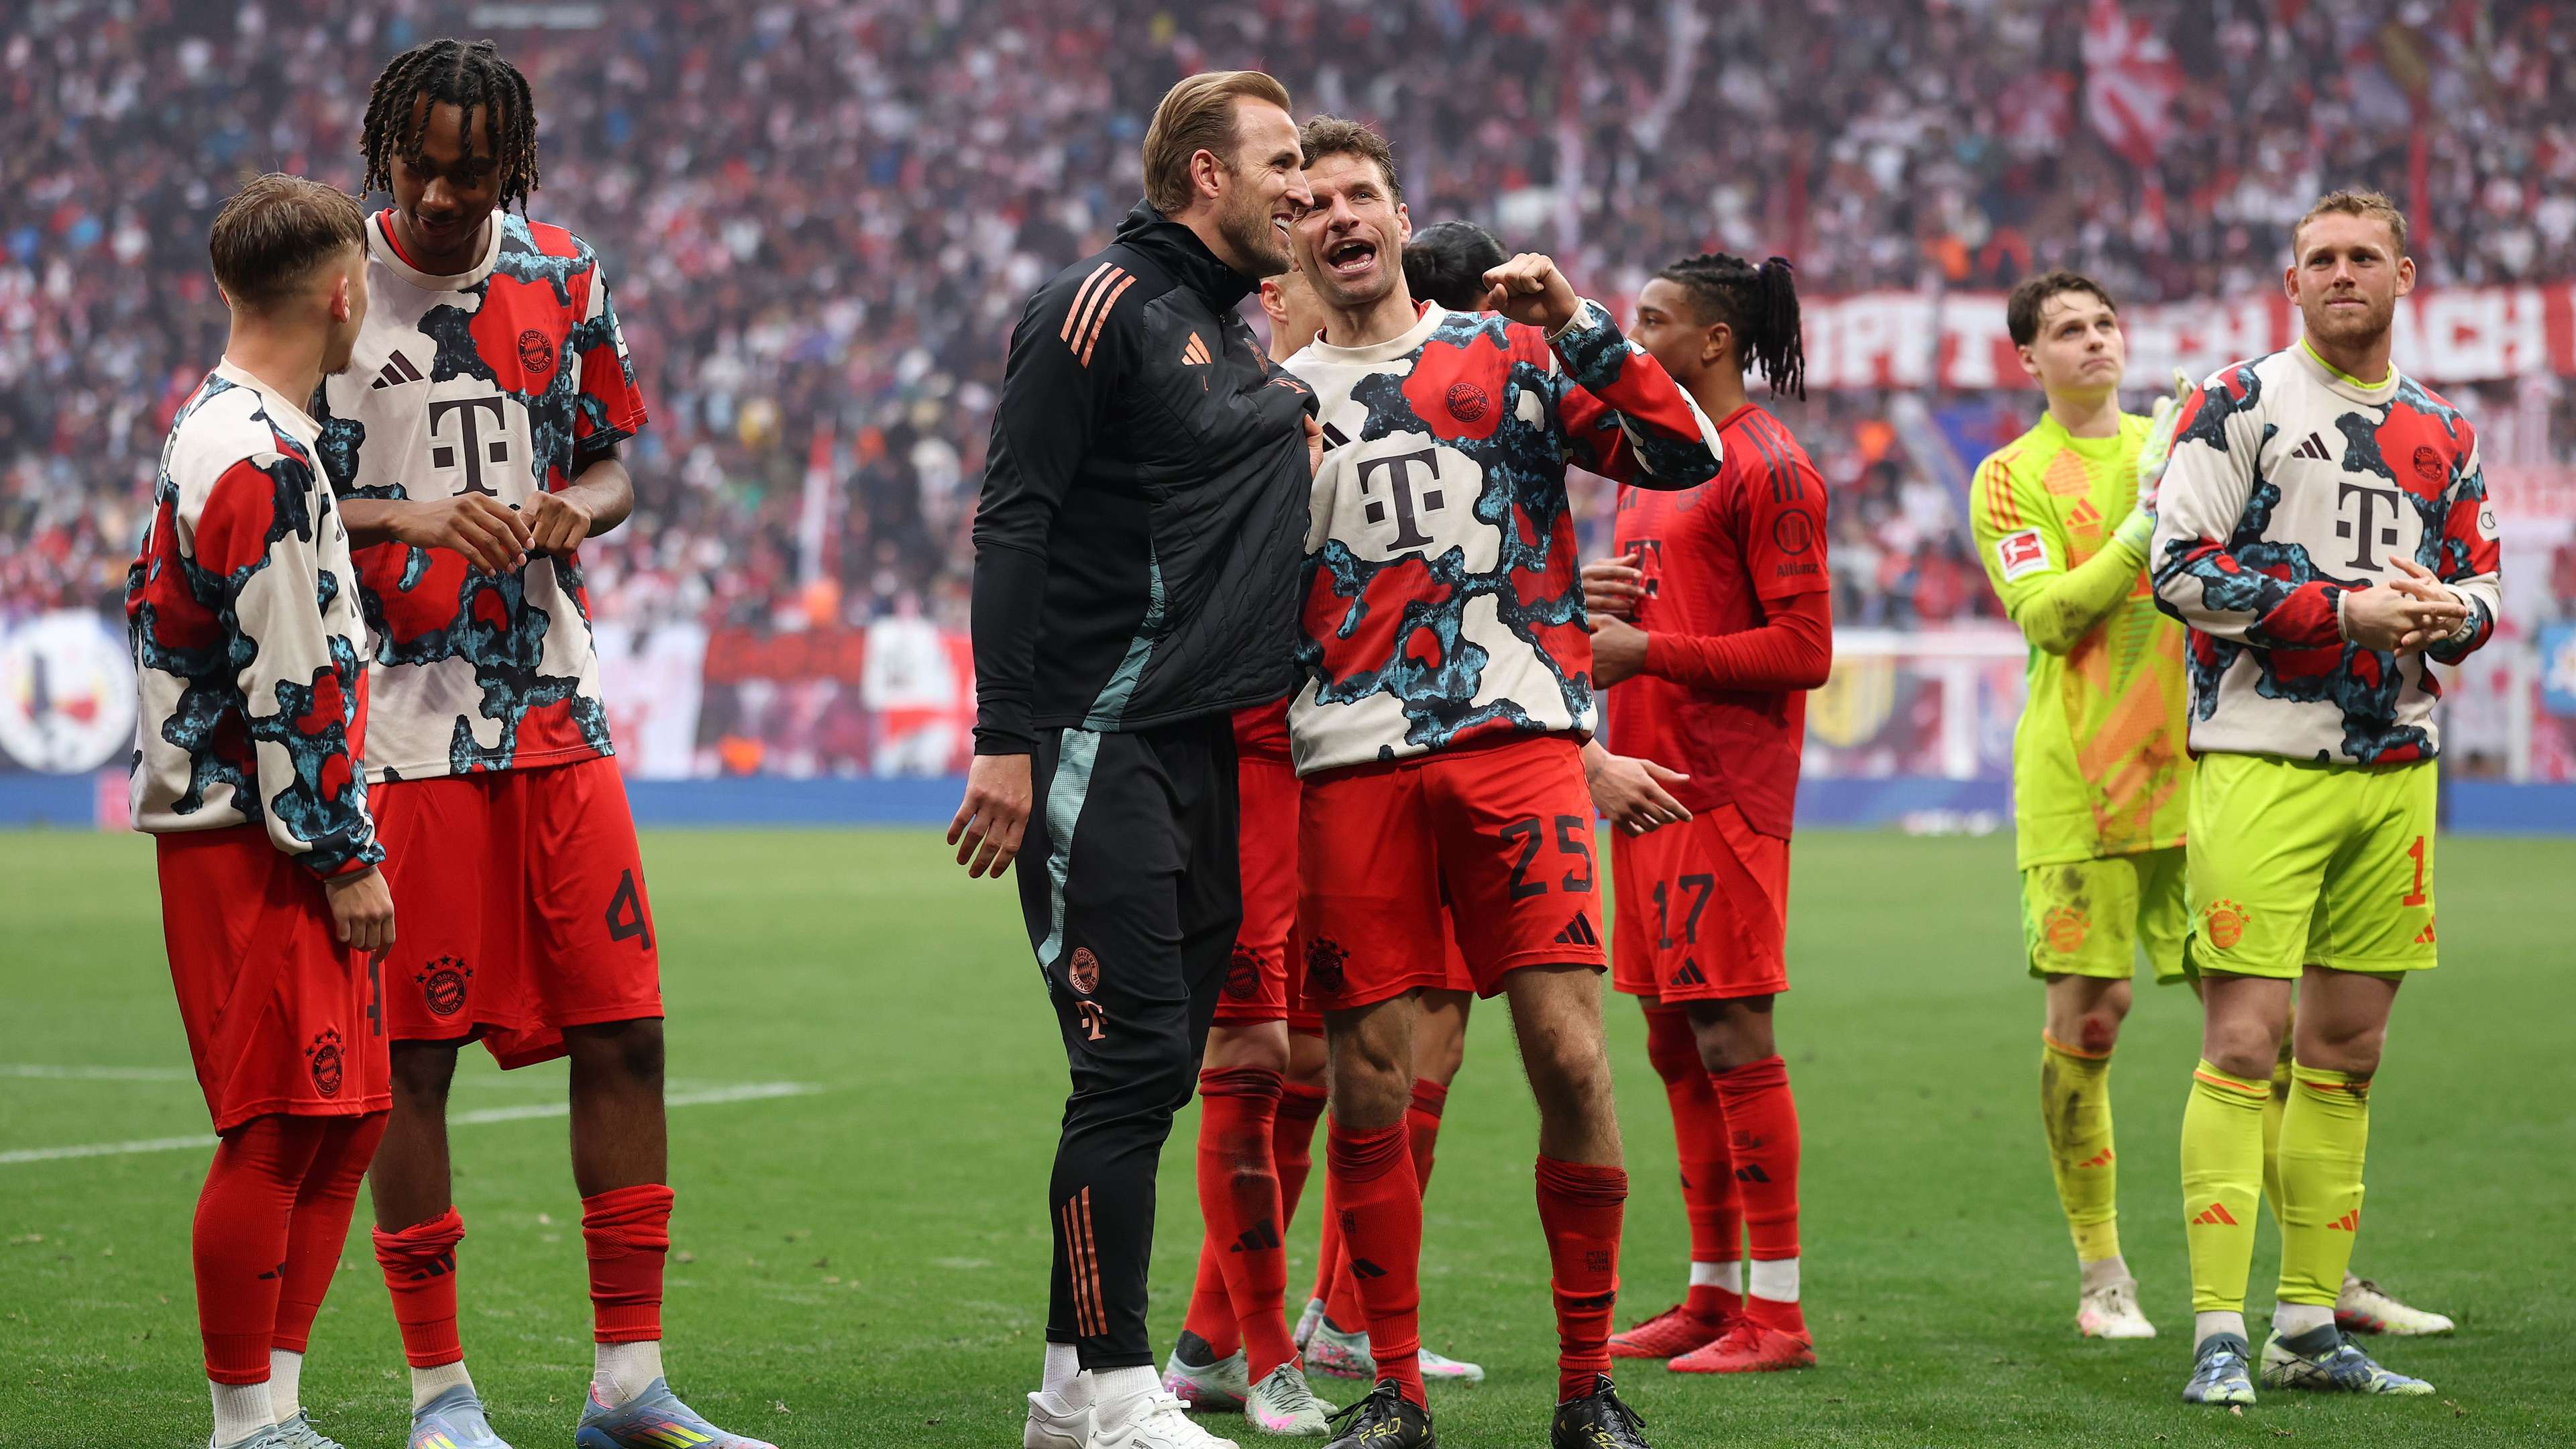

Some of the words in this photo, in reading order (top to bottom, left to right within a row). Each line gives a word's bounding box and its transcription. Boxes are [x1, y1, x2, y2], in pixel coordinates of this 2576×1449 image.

[1455, 384, 1485, 398] BAYERN
[428, 396, 508, 497] T
[1356, 447, 1445, 552] T
[2336, 482, 2398, 572] T
[1777, 562, 1819, 578] Allianz
[1500, 814, 1593, 901] 25
[2403, 836, 2426, 907] 1
[605, 868, 651, 951] 4
[1652, 873, 1715, 950] 17
[1077, 952, 1095, 969] BAYERN
[1075, 1000, 1108, 1041] T
